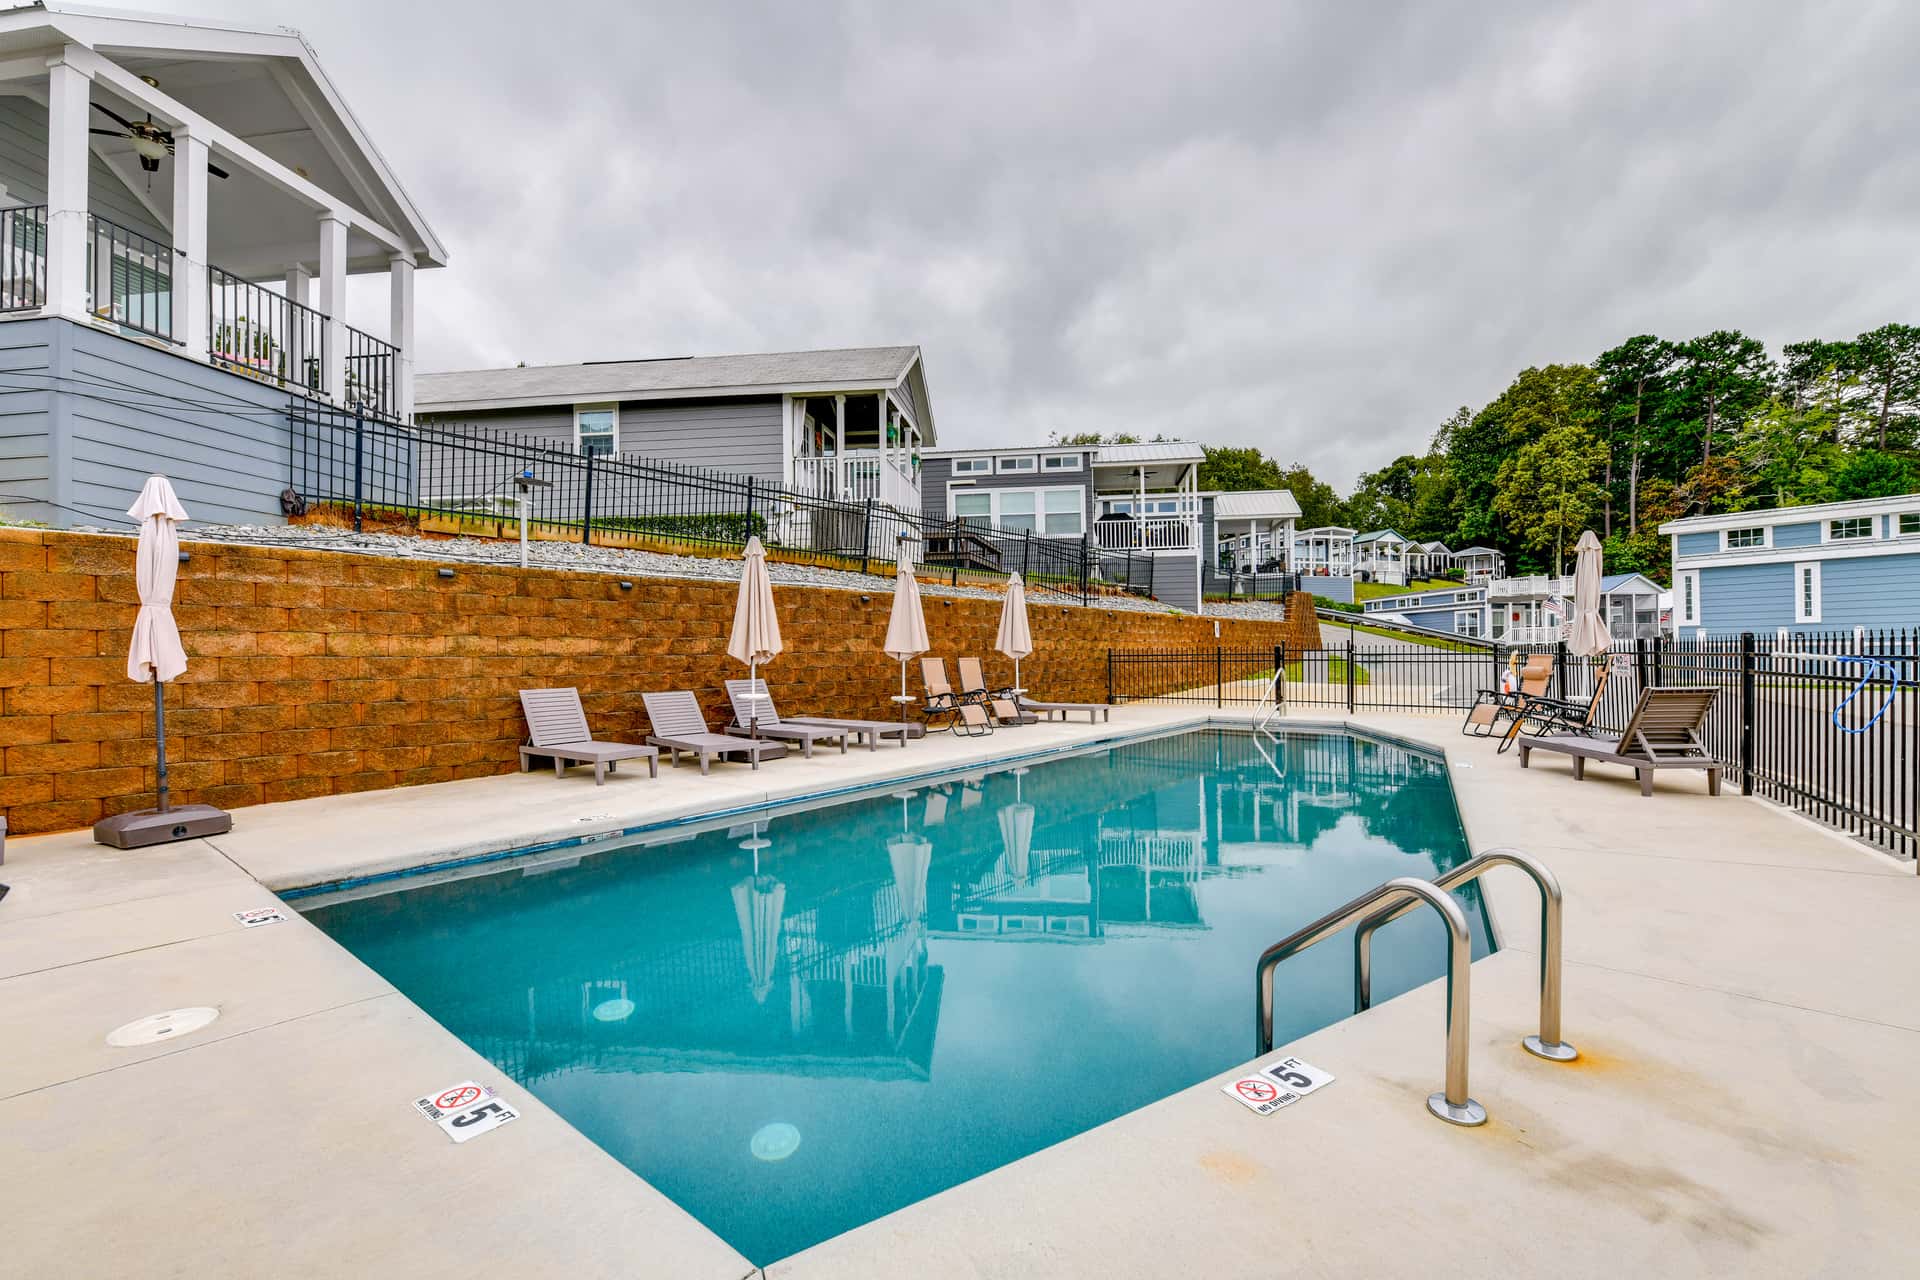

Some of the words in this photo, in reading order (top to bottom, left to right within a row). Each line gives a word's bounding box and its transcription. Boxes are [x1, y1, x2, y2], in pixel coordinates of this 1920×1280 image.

[1283, 1058, 1302, 1069] FT
[1269, 1065, 1312, 1088] 5
[423, 1104, 444, 1119] DIVING
[1258, 1104, 1271, 1112] NO
[1269, 1092, 1296, 1107] DIVING
[452, 1102, 503, 1127] 5
[494, 1111, 516, 1122] FT
